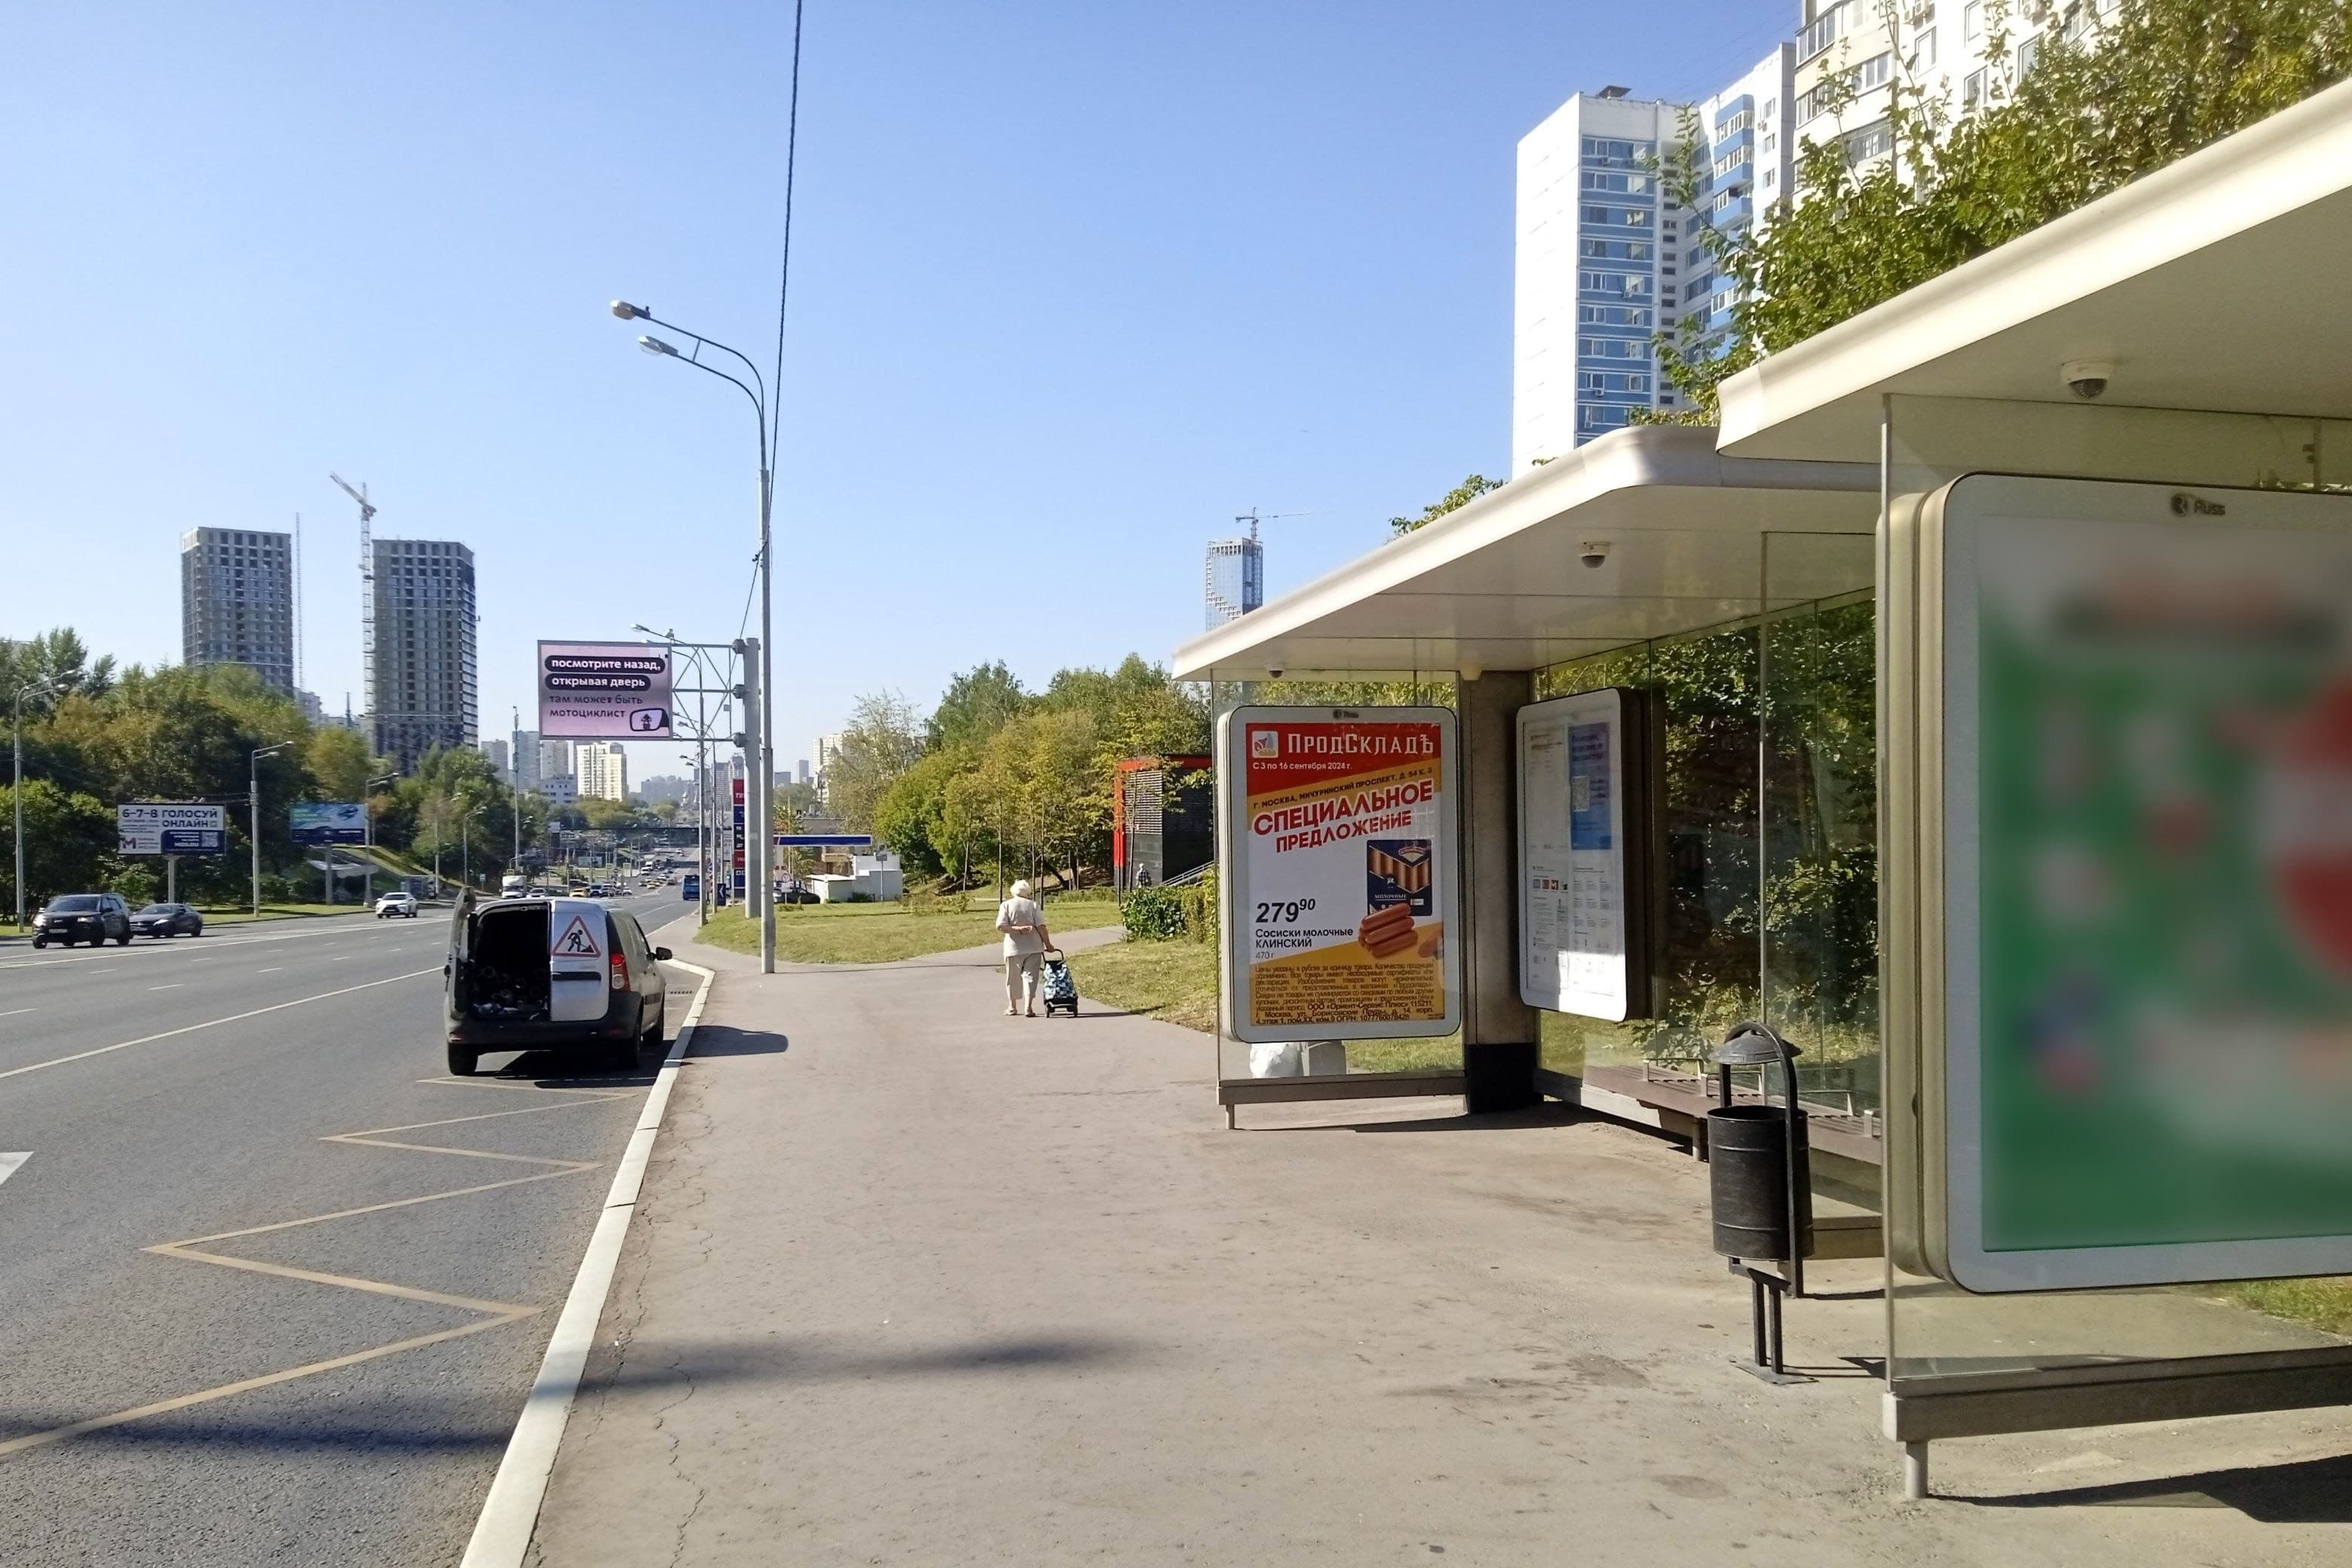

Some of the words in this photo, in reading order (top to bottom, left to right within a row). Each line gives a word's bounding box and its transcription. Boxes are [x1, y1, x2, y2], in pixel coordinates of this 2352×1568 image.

[551, 660, 622, 670] посмотрите
[623, 660, 661, 671] назад,
[552, 678, 608, 688] открывая
[610, 679, 645, 688] дверь
[614, 694, 643, 704] быть
[550, 709, 626, 718] мотоциклист
[1289, 762, 1327, 770] сентября
[1299, 782, 1355, 799] МИЧУРИНСКИЙ
[1254, 779, 1432, 836] СПЕЦИАЛЬНОЕ
[162, 808, 217, 818] ГОЛОСУЙ
[162, 819, 208, 828] ОНЛАЙН
[1276, 810, 1412, 853] ПРЕДЛОЖЕНИЕ
[1255, 902, 1299, 923] 279
[1299, 898, 1315, 911] 90
[1255, 929, 1301, 938] Сосиски
[1303, 929, 1354, 937] молочные
[1255, 936, 1312, 948] КЛИНСКИЙ
